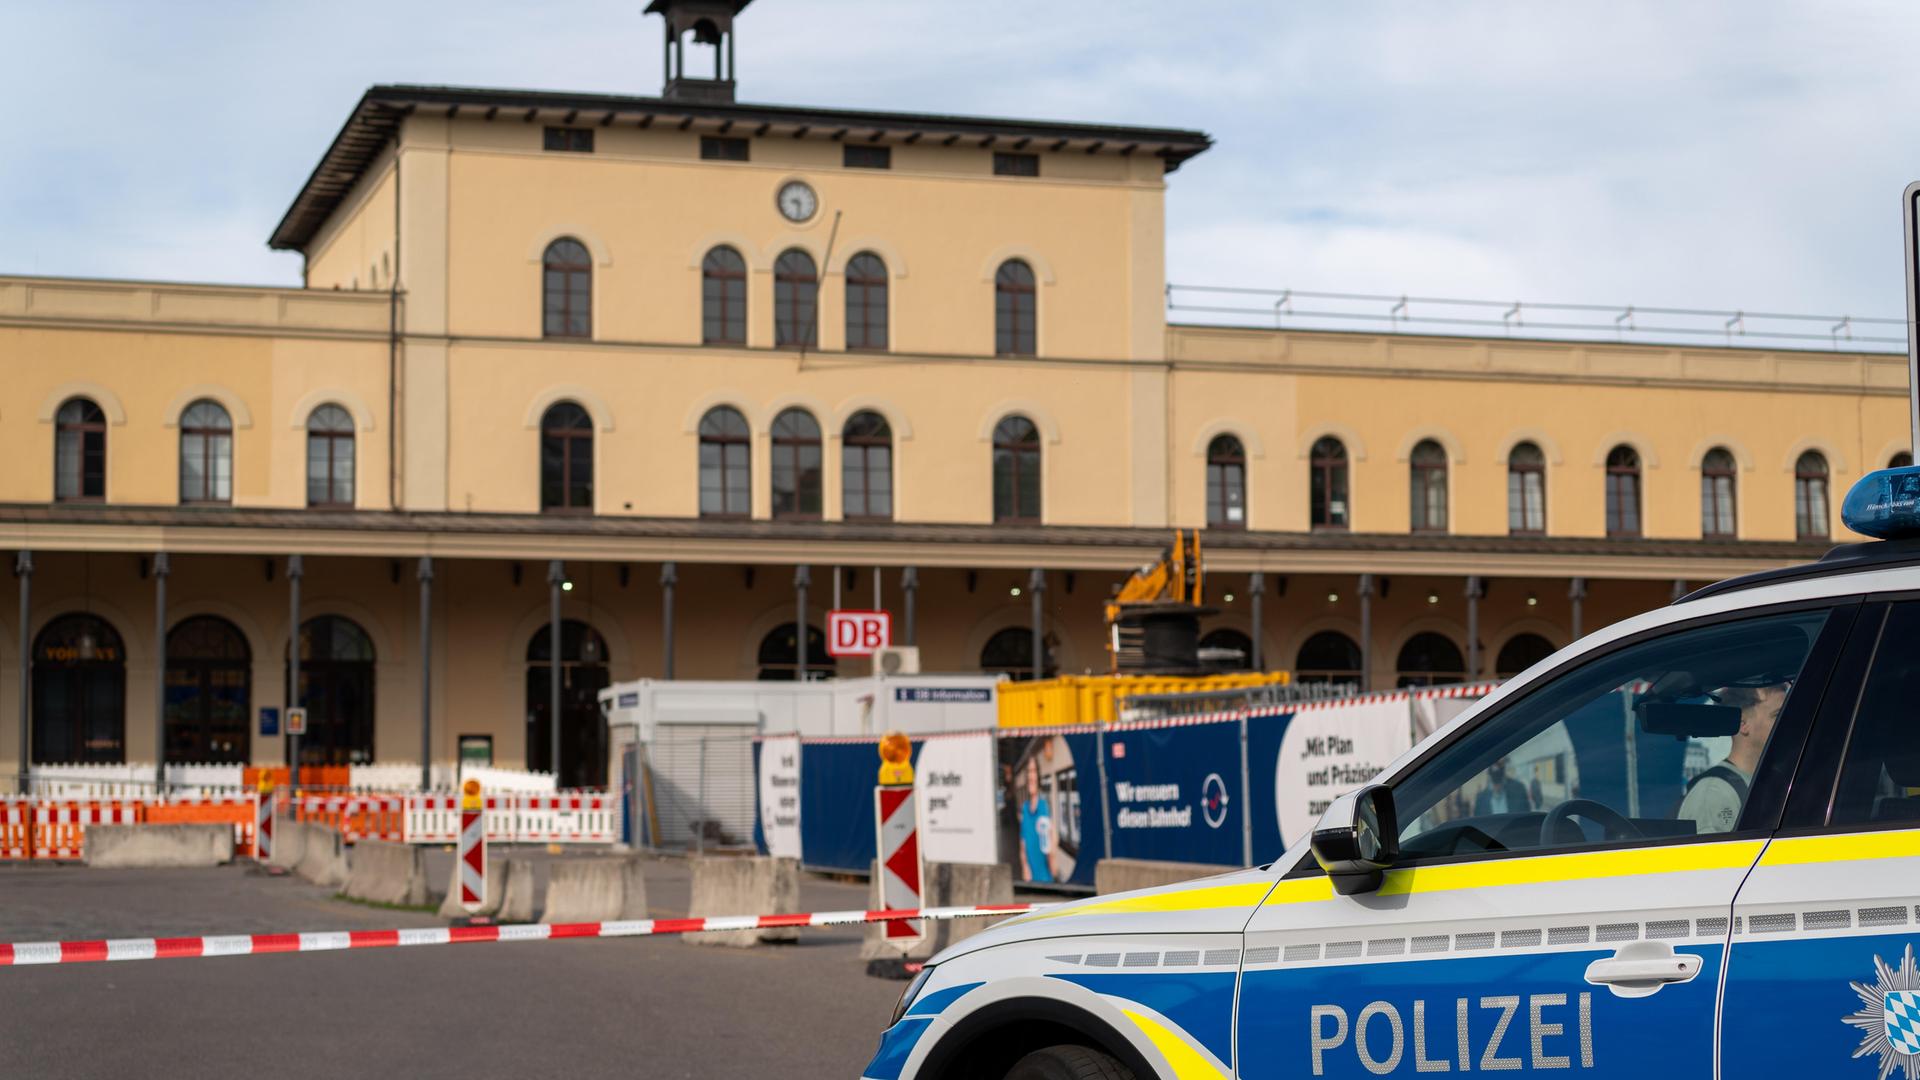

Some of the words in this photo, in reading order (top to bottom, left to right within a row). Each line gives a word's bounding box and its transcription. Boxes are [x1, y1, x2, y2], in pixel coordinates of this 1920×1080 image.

[837, 619, 882, 649] DB
[933, 689, 987, 699] Information
[1328, 735, 1353, 755] Plan
[1307, 766, 1329, 786] und
[1332, 762, 1385, 785] Präzisio
[1115, 781, 1134, 802] Wir
[1135, 783, 1179, 802] erneuern
[1117, 806, 1147, 828] diesen
[1148, 804, 1192, 828] Bahnhof
[1310, 991, 1594, 1077] POLIZEI
